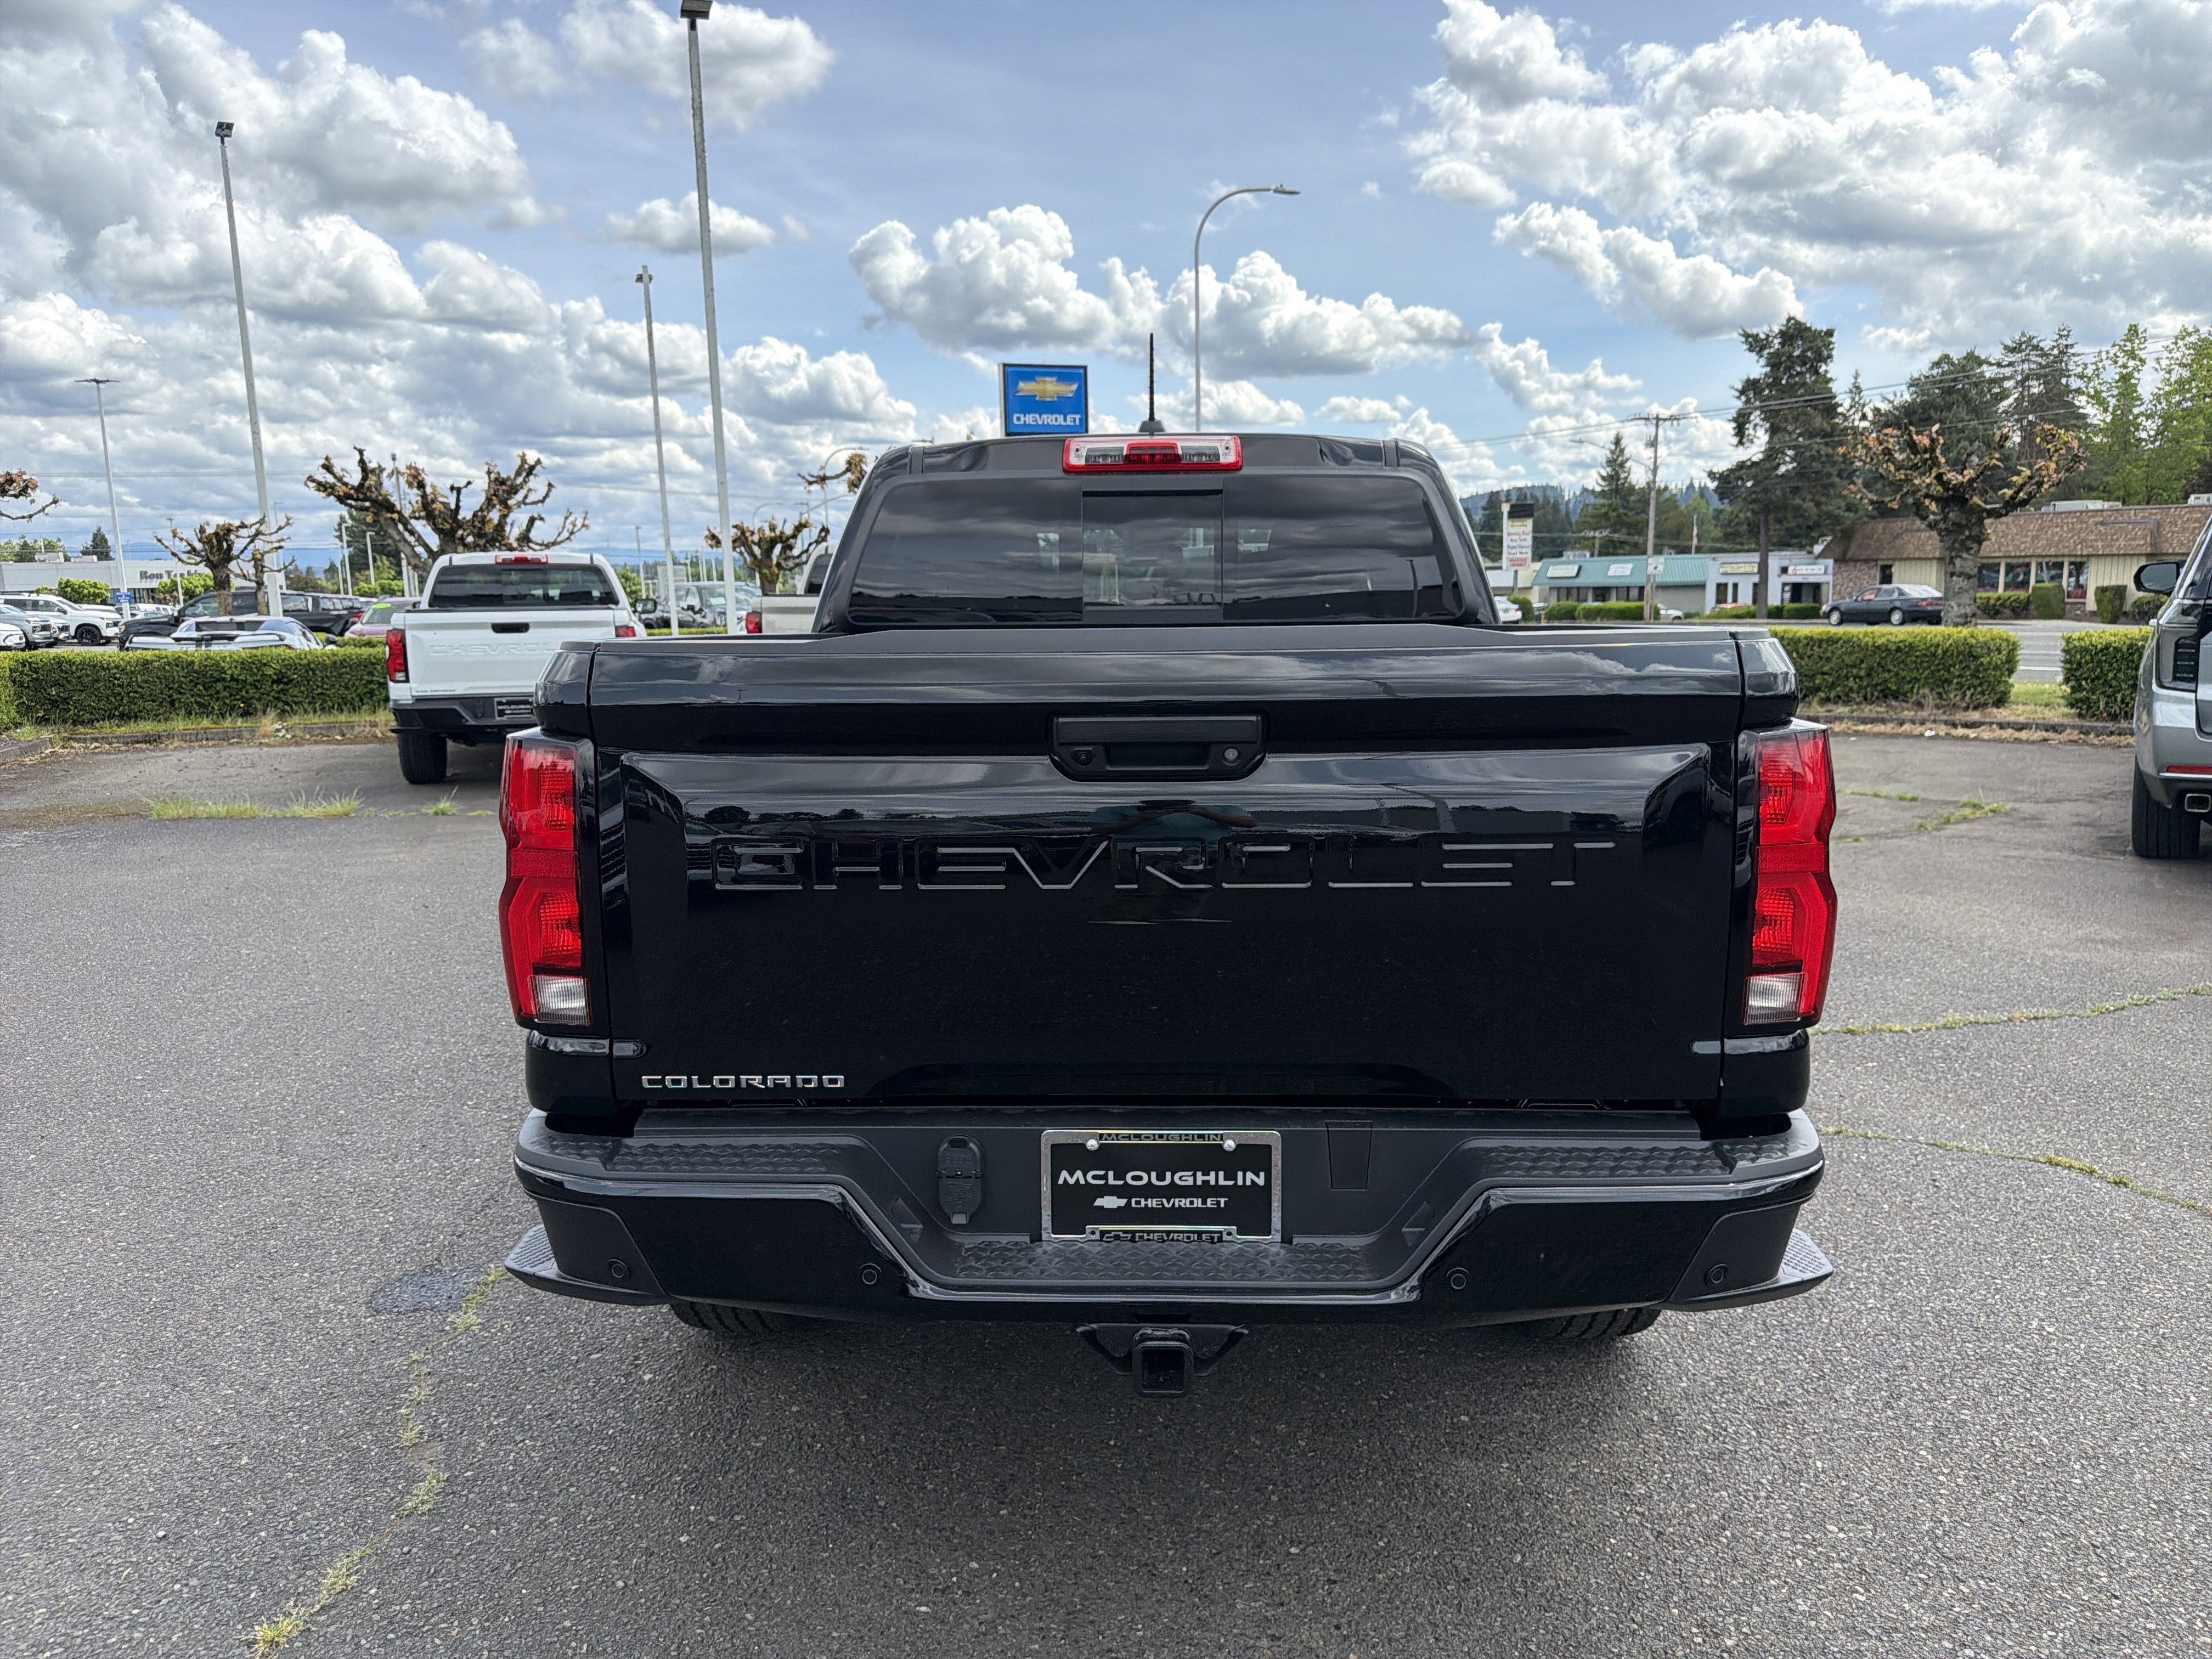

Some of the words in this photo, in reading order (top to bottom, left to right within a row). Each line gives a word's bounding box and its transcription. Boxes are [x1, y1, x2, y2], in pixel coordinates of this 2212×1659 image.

[1013, 413, 1081, 426] CHEVROLET
[139, 570, 164, 580] Ron
[712, 837, 1616, 890] CHEVROLET
[641, 1075, 845, 1088] COLORADO
[1102, 1133, 1222, 1142] MCLOUGHLIN
[1057, 1169, 1266, 1186] MCLOUGHLIN
[1131, 1197, 1228, 1208] CHEVROLET
[1135, 1232, 1222, 1243] CHEVROLET
